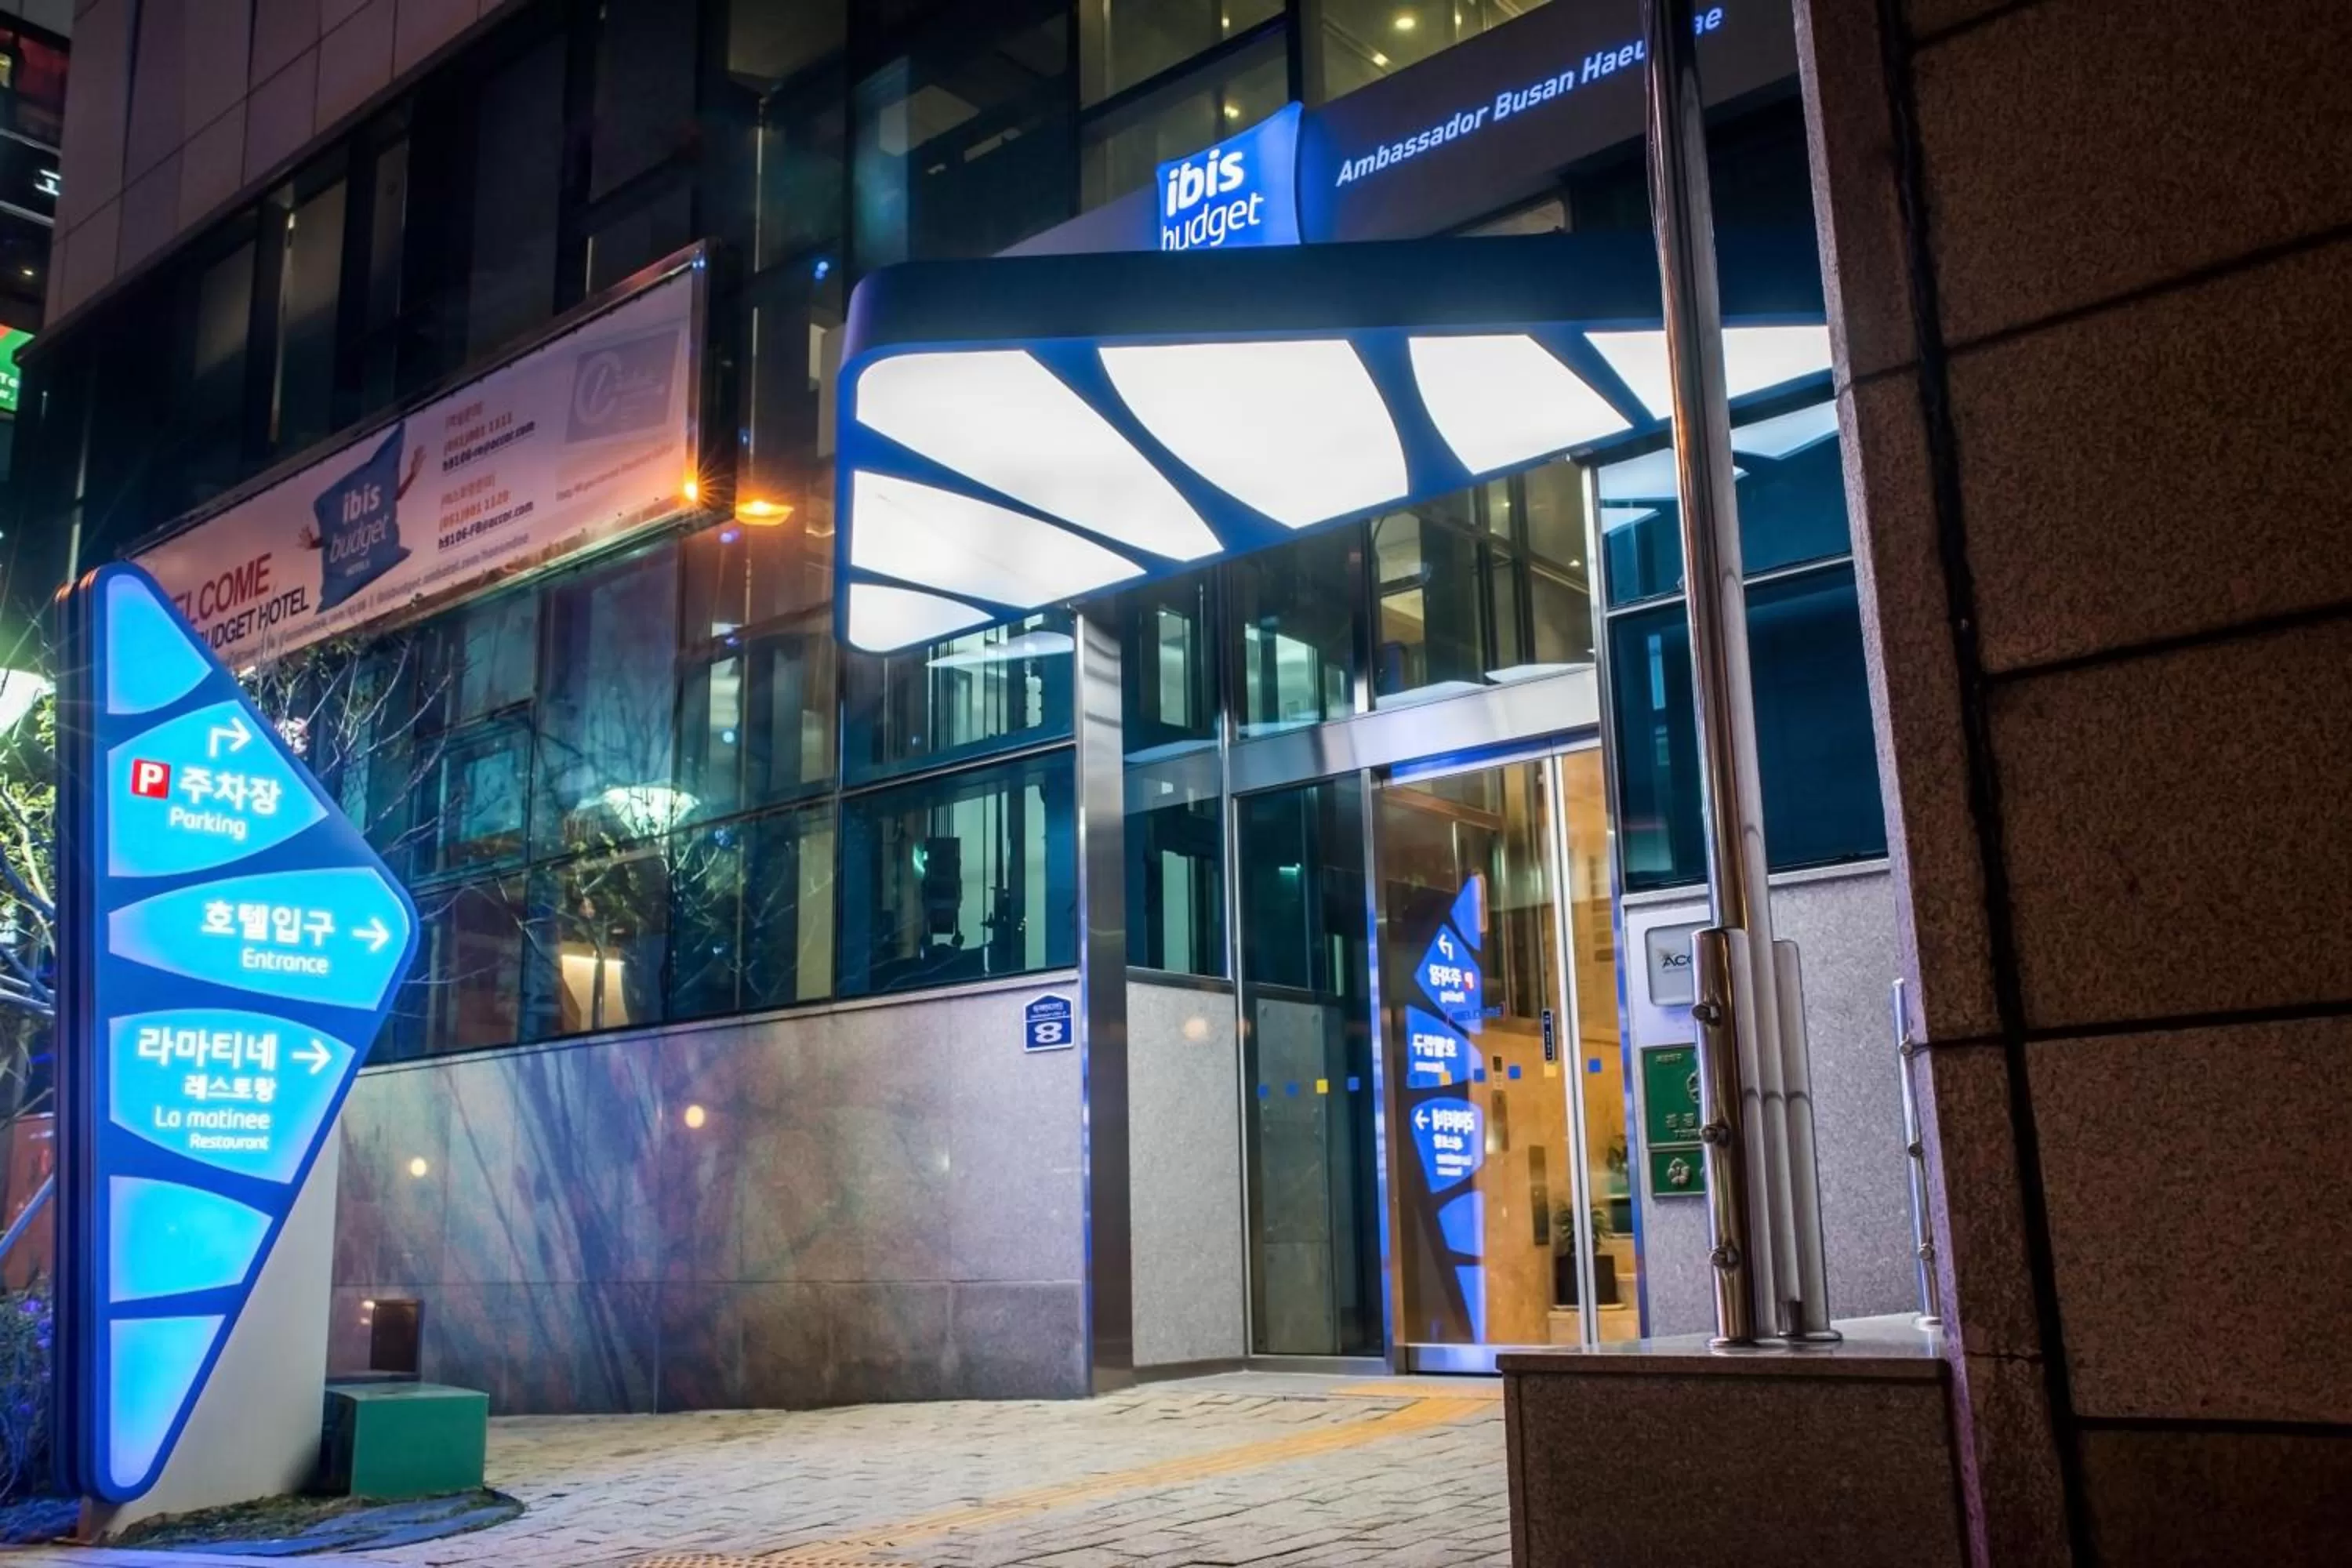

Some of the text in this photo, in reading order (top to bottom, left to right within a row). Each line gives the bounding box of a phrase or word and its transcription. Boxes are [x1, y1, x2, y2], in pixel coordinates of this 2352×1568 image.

[1335, 106, 1490, 187] Ambassador
[1493, 70, 1574, 122] Busan
[1167, 148, 1244, 218] ibis
[1162, 192, 1265, 251] budget
[343, 483, 381, 524] ibis
[329, 512, 389, 564] budget
[258, 586, 310, 631] HOTEL
[139, 762, 281, 815] P 주차장
[169, 807, 246, 840] Parking
[201, 900, 336, 946] 호텔입구
[241, 947, 329, 975] Entrance
[137, 1027, 278, 1071] 라마티네
[1035, 1022, 1062, 1044] 8
[184, 1075, 277, 1102] 레스토랑
[155, 1105, 270, 1130] La matinee
[190, 1133, 270, 1151] Restaurant
